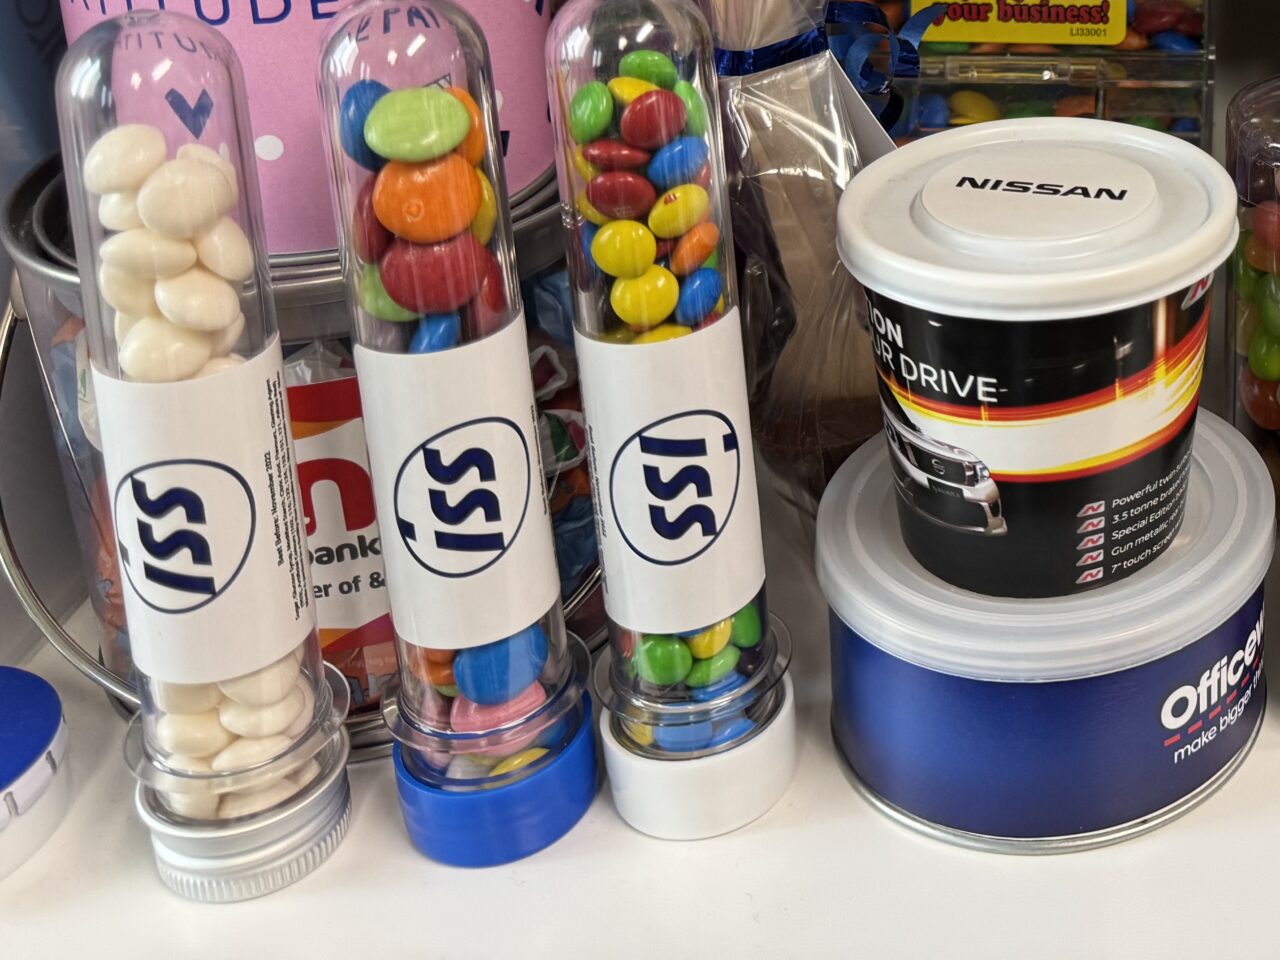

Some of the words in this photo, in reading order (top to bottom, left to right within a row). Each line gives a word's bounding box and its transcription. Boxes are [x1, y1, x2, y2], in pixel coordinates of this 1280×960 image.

[955, 176, 1128, 201] NISSAN
[267, 473, 278, 514] November
[1111, 480, 1158, 509] Powerful
[1111, 511, 1129, 525] 3.5
[1130, 497, 1159, 517] tonne
[1111, 517, 1148, 541] Special
[1149, 499, 1175, 522] Edition
[1111, 543, 1133, 557] Gun
[1135, 520, 1168, 546] metallic
[276, 546, 284, 566] Best
[1123, 548, 1152, 570] touch
[338, 574, 362, 596] of
[1174, 724, 1218, 764] make
[1219, 681, 1253, 732] bigger
